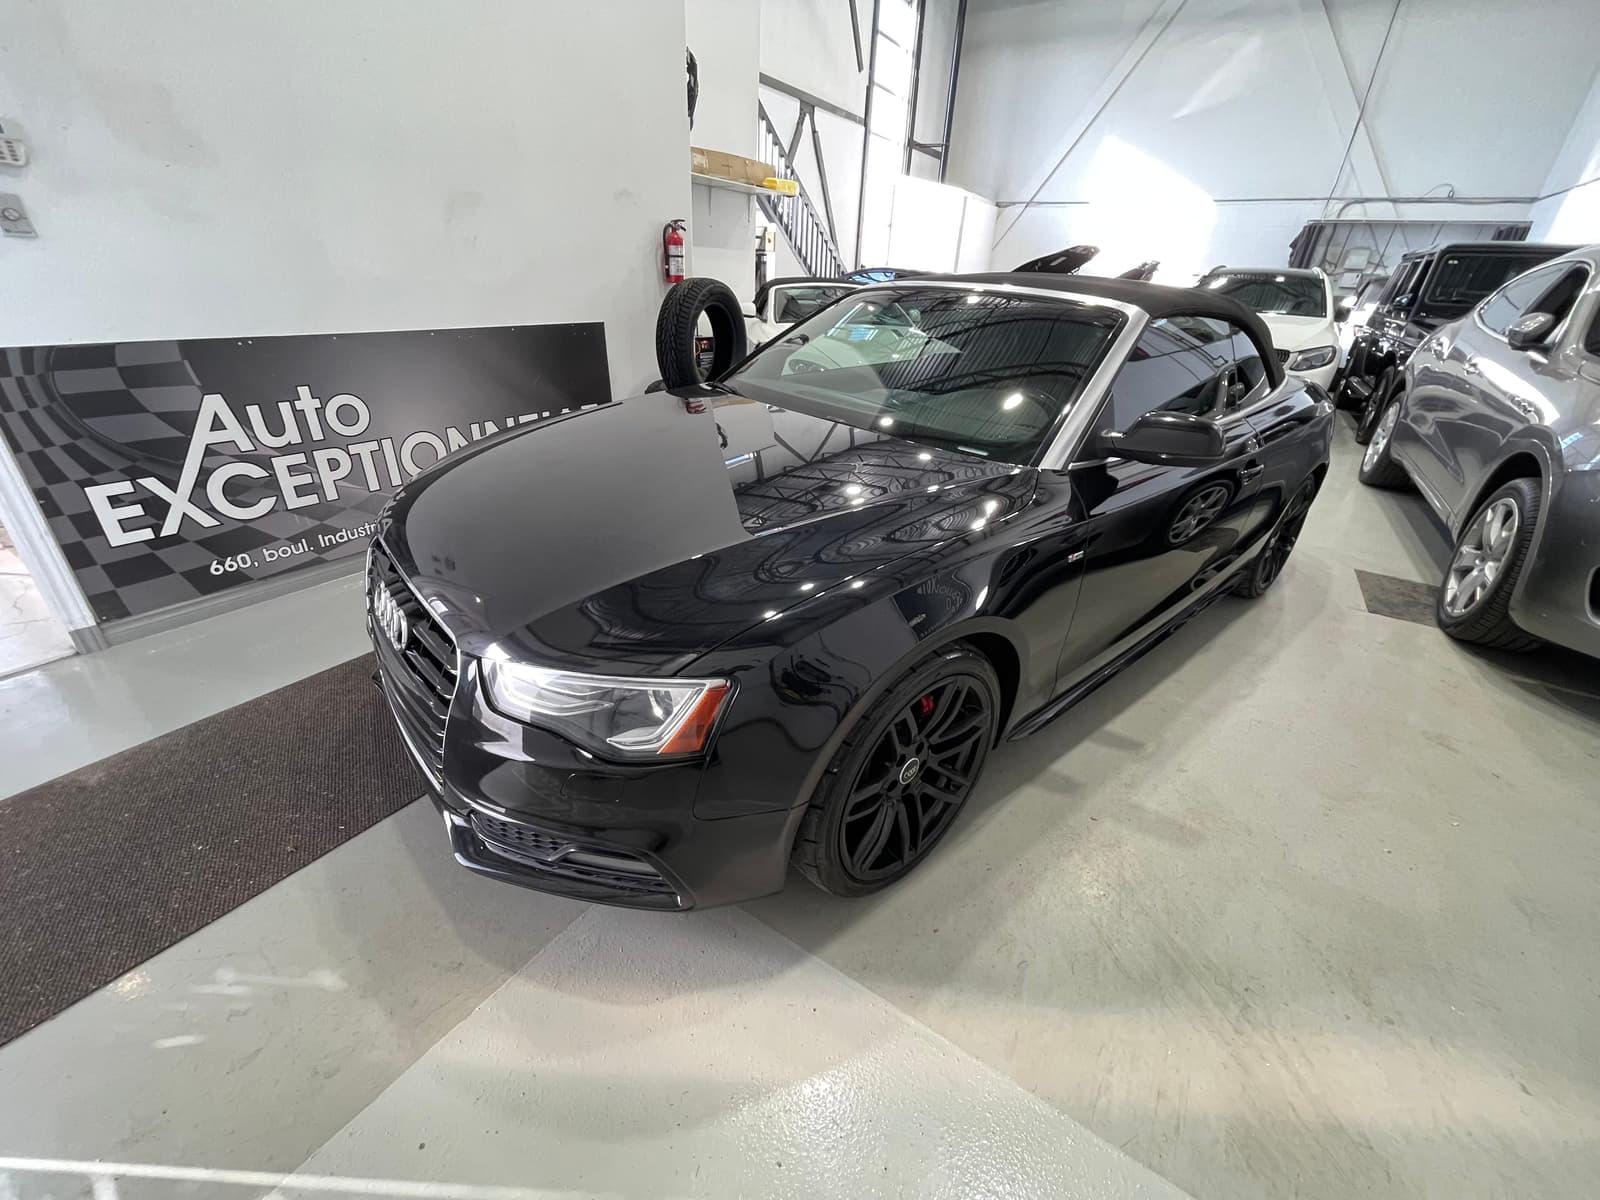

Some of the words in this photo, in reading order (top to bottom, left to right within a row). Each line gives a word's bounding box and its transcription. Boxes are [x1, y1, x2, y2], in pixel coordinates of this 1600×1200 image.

[191, 385, 371, 452] Auto
[209, 553, 259, 575] 660,
[263, 538, 314, 562] boul.
